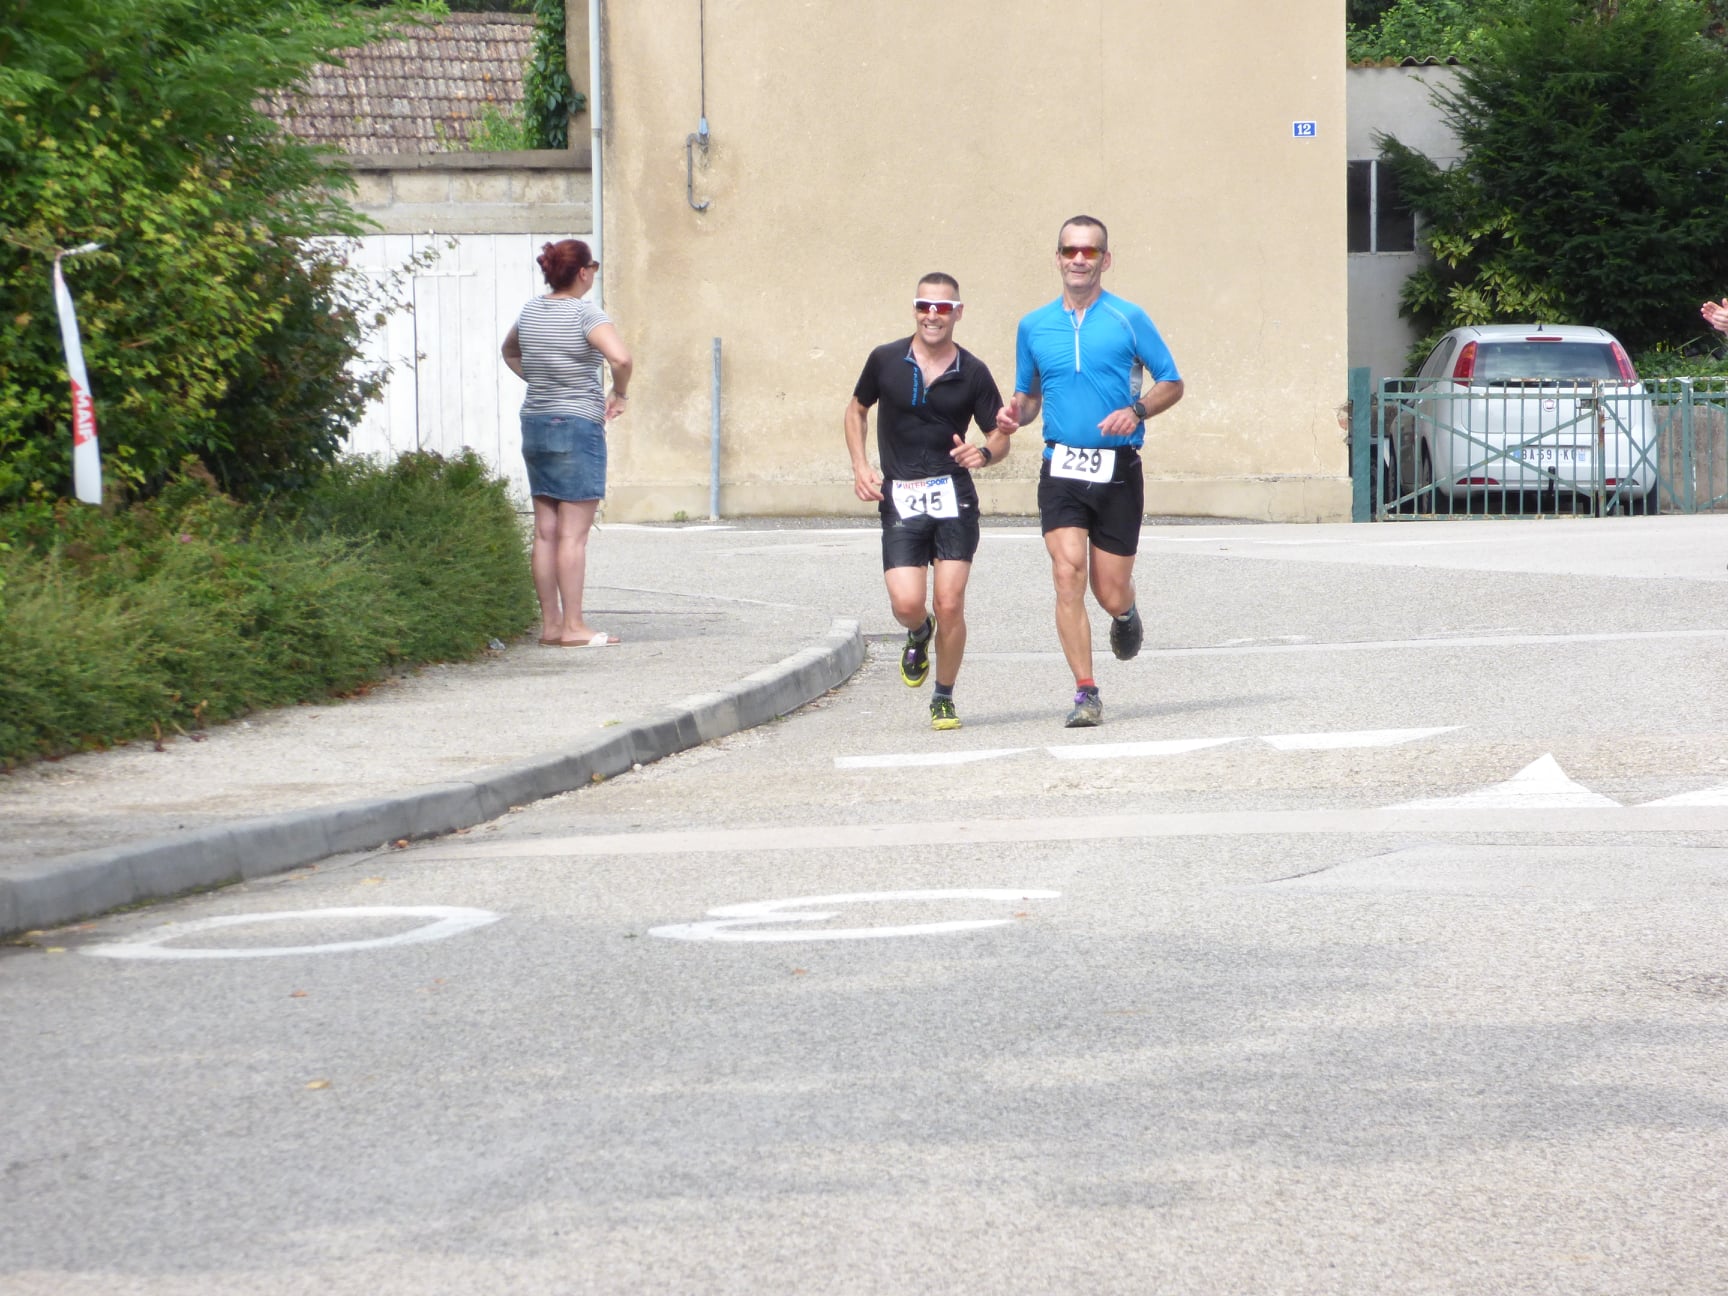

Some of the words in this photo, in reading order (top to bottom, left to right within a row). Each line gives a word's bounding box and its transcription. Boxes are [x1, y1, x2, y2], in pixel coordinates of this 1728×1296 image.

[1297, 123, 1312, 135] 12
[76, 390, 93, 440] MAIF
[1062, 448, 1102, 474] 229
[903, 477, 949, 489] INTERSPORT
[904, 491, 943, 514] 215
